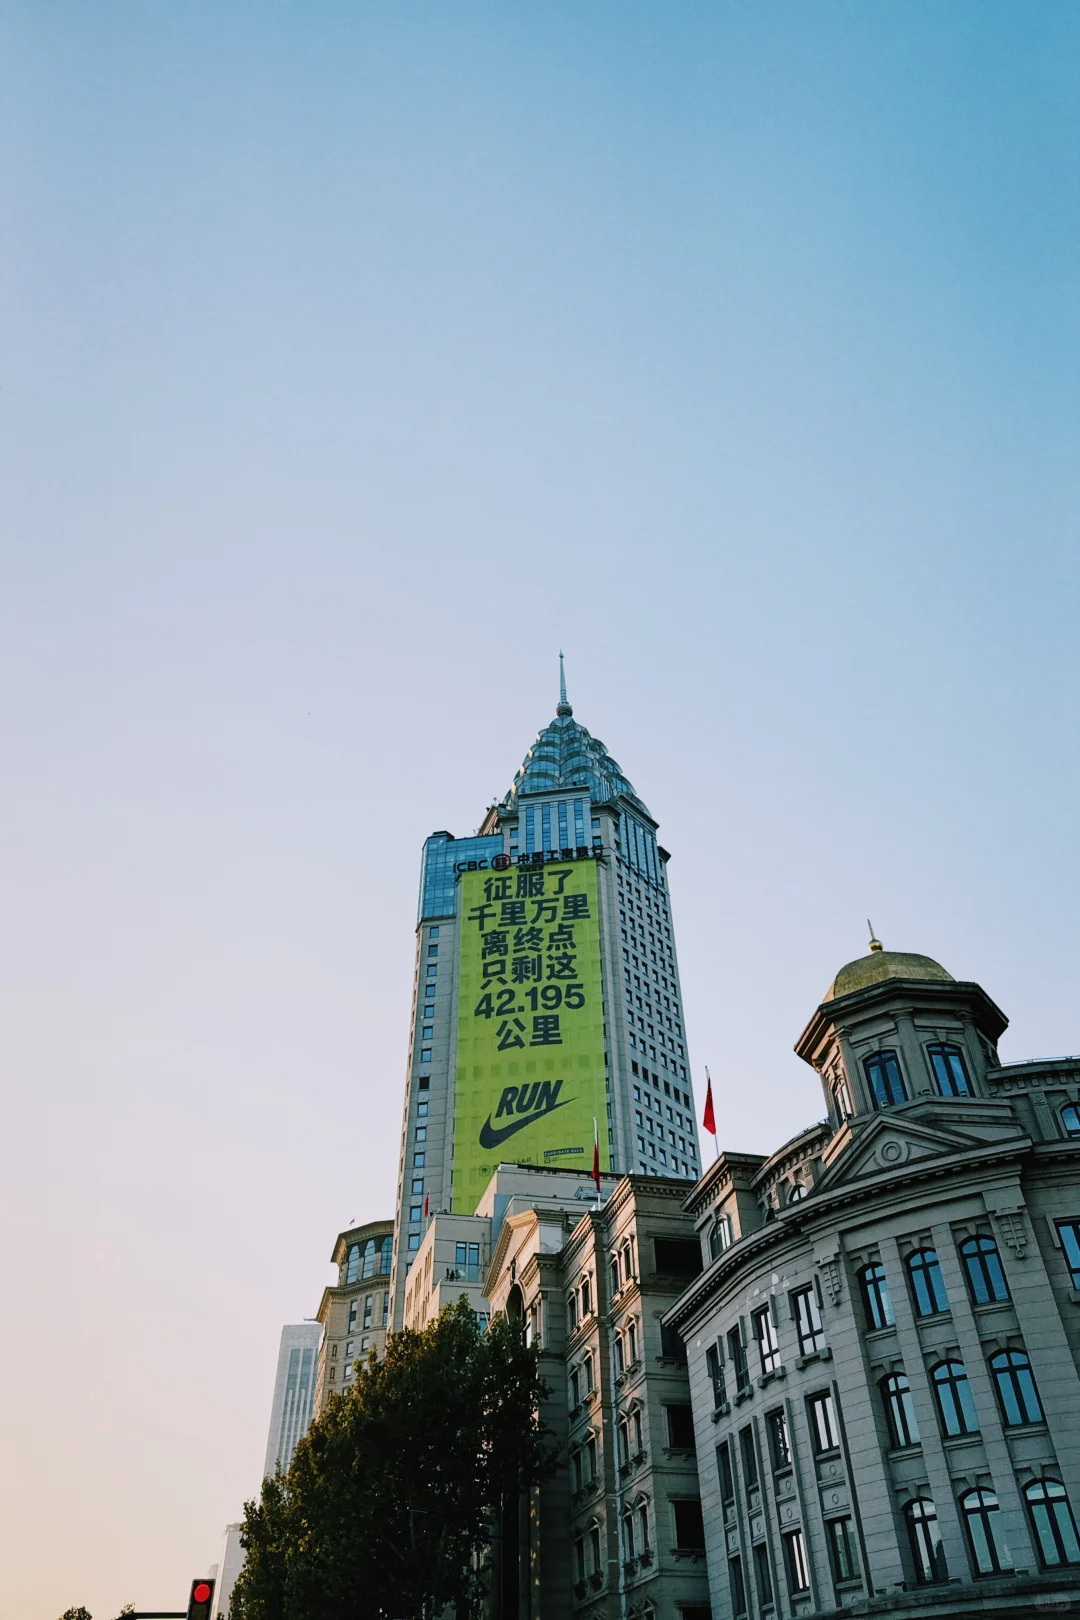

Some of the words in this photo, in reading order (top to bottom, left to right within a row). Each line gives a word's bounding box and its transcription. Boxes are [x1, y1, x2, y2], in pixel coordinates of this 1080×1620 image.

[453, 859, 488, 872] ICBC
[483, 869, 574, 902] 征服了
[467, 893, 591, 931] 千里万里
[481, 923, 577, 960] 离终点
[480, 952, 578, 990] 只剩这
[474, 984, 586, 1020] 42.195
[495, 1014, 563, 1052] 公里
[495, 1079, 564, 1119] RUN
